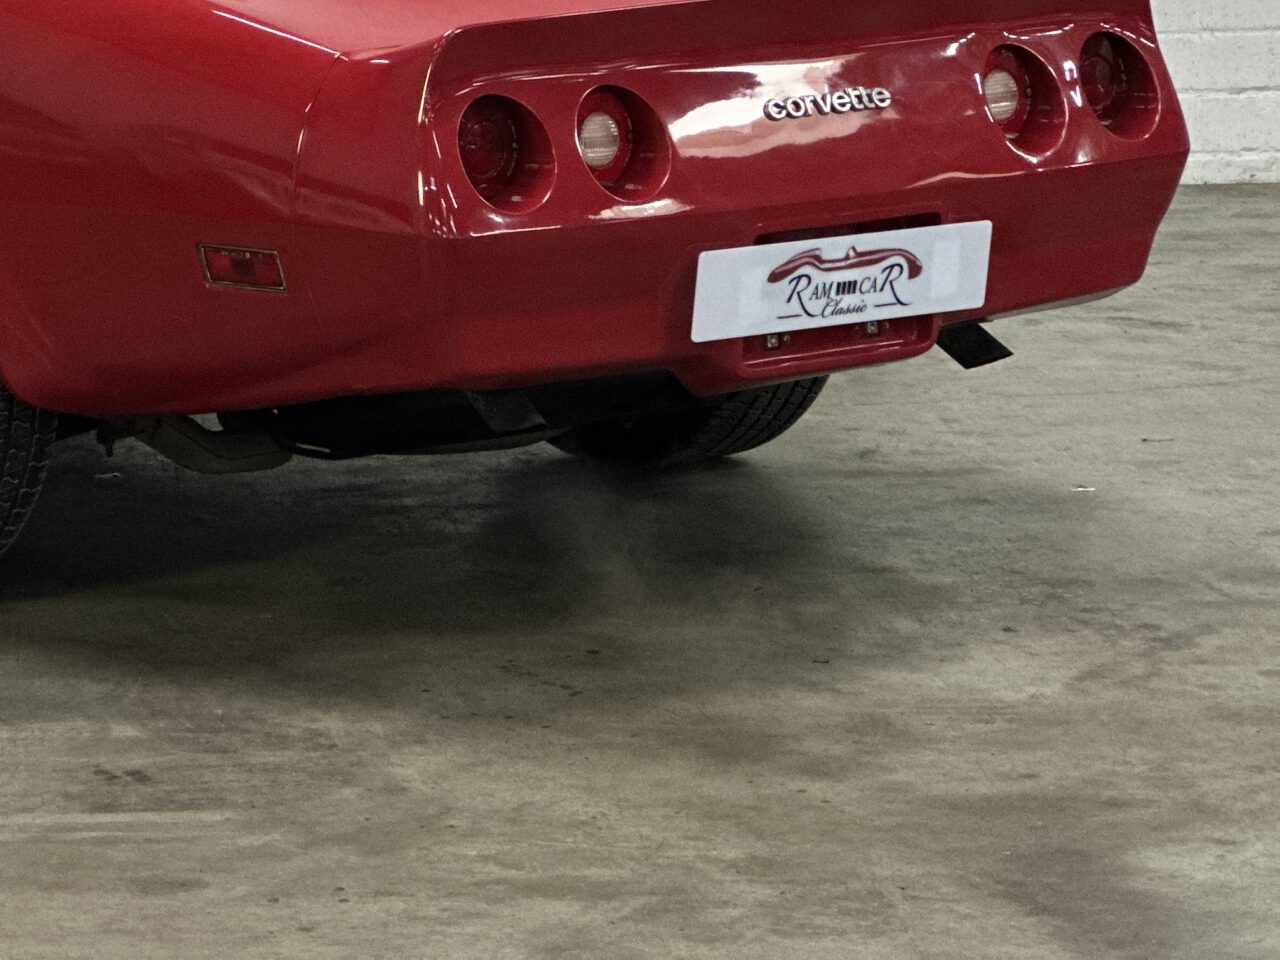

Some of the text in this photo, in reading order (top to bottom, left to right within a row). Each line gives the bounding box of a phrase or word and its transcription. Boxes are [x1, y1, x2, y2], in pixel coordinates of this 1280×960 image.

[785, 263, 912, 317] RAM CAR
[821, 297, 868, 318] Classic
